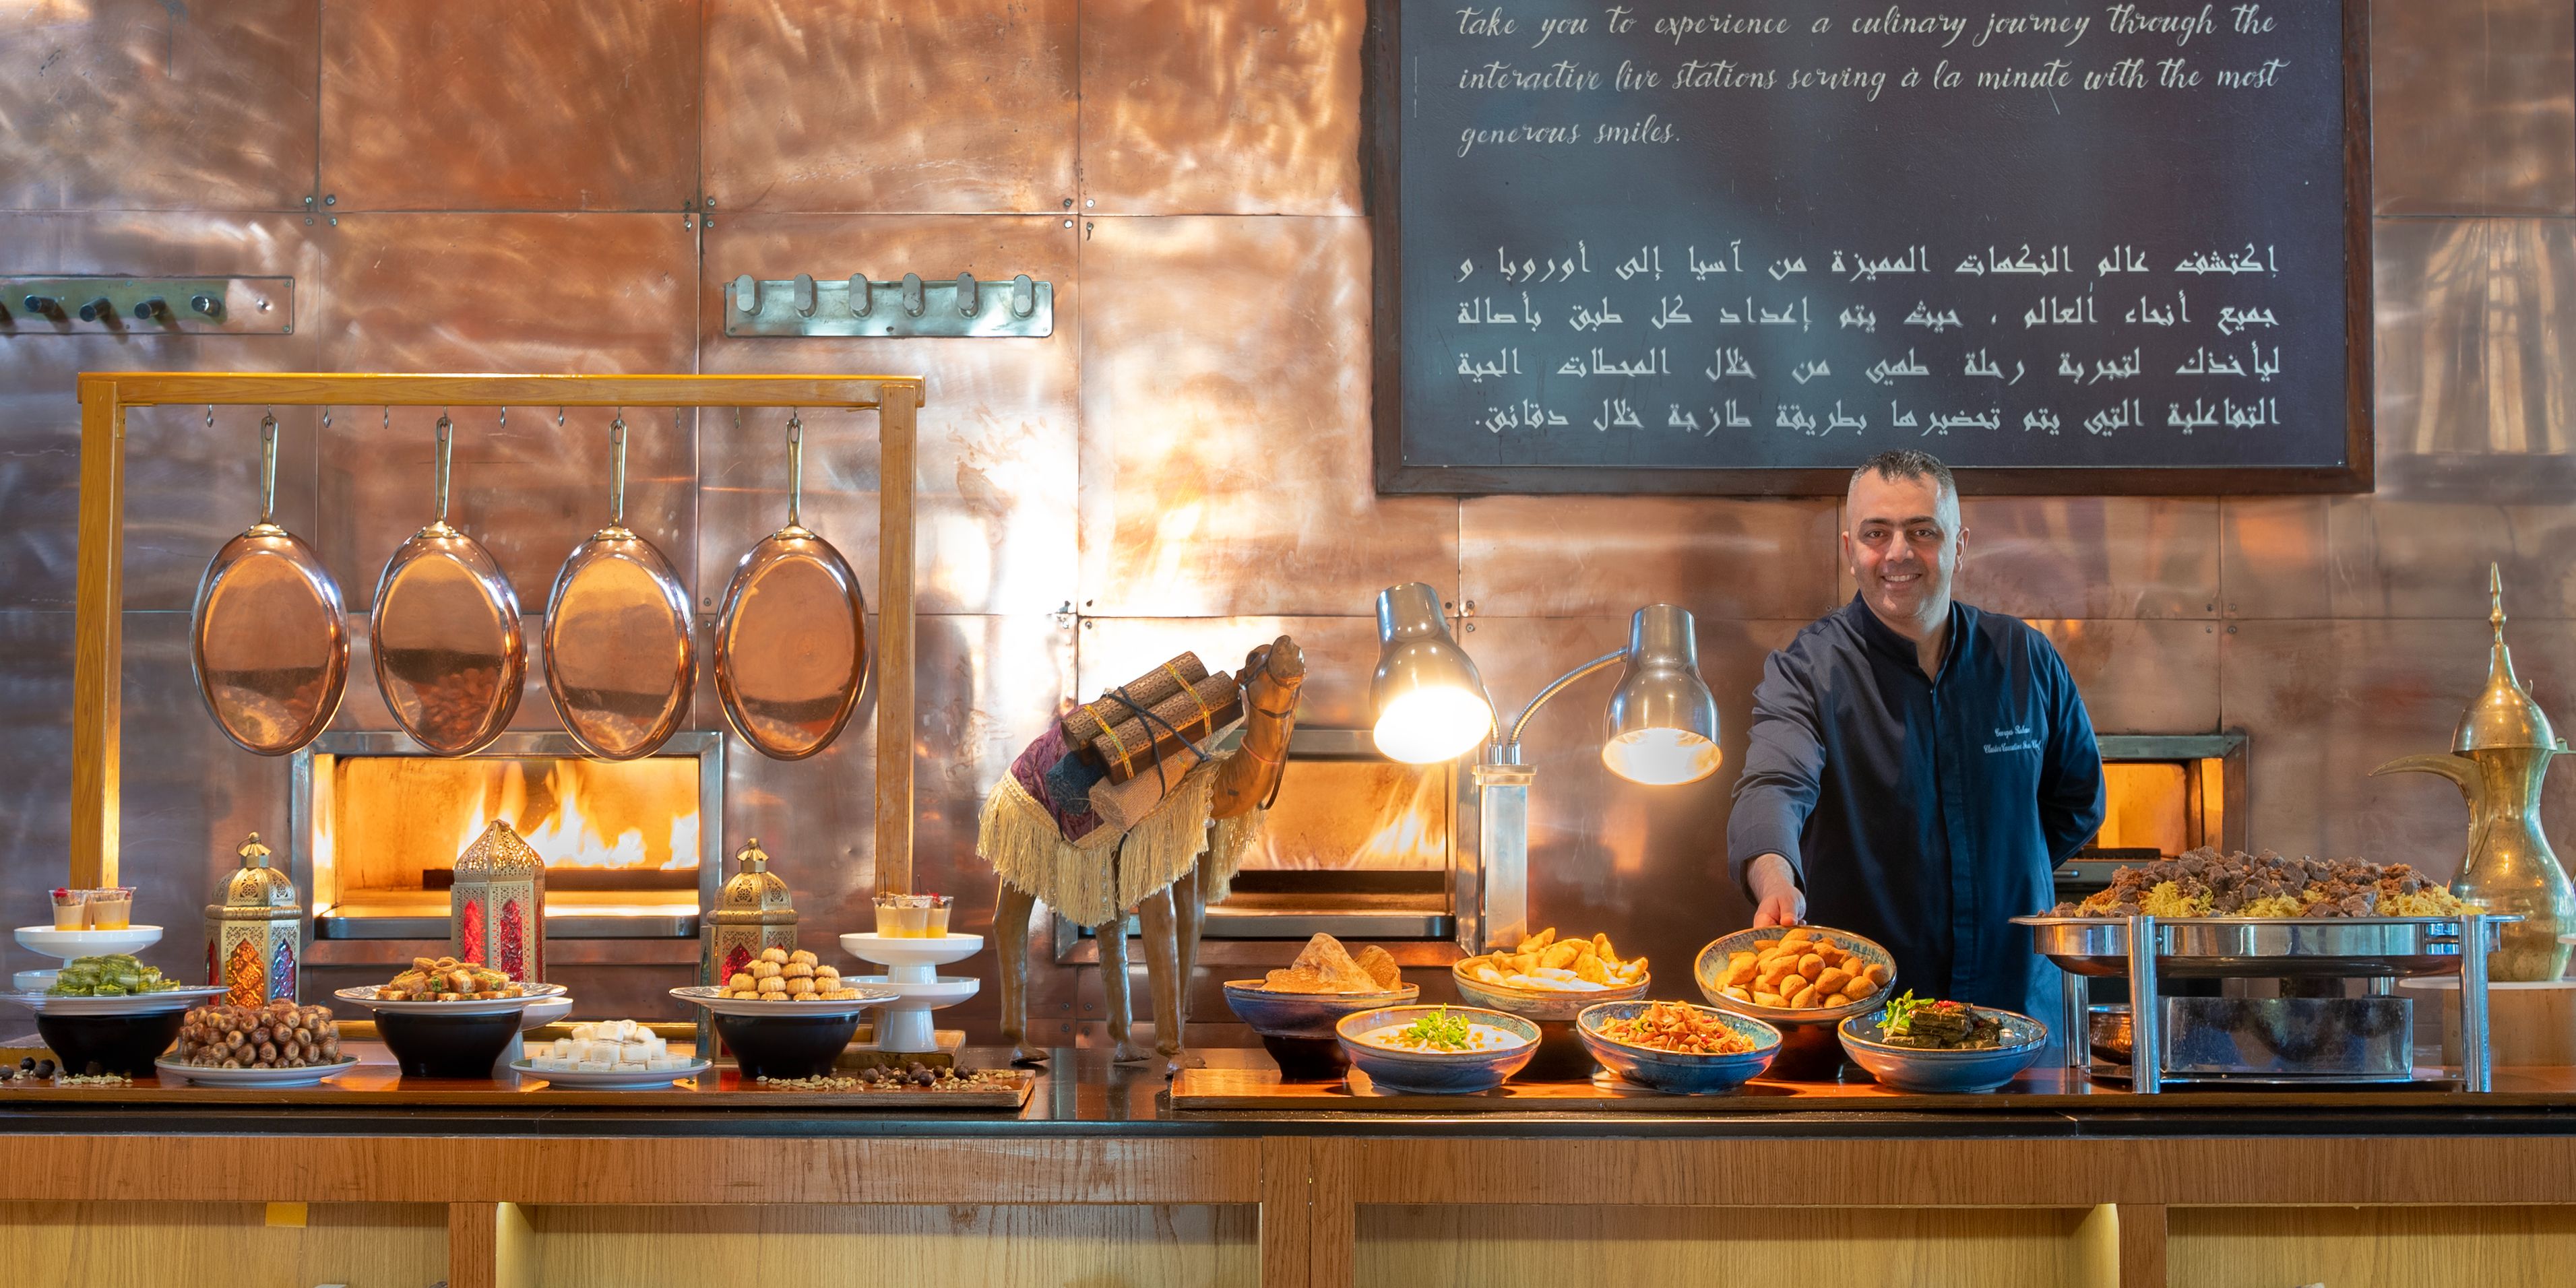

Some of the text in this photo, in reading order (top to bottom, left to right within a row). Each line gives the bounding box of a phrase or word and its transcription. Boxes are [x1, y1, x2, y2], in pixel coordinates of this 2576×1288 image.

[1455, 3, 2277, 49] take you to experience a culinary journey through the
[1459, 57, 2291, 102] interactive live stations serving à la minute with the most
[1457, 114, 1680, 158] generous smiles.
[1457, 258, 1474, 283] و
[1498, 239, 1591, 283] أوروبا
[1614, 245, 1664, 282] إلى
[1688, 238, 1744, 282] آسيا
[1768, 256, 1808, 281] من
[1831, 245, 1931, 282] المميزة
[1954, 243, 2074, 277] النكهات
[2098, 244, 2150, 278] عالم
[1457, 290, 1542, 333] بأصالة
[1569, 296, 1624, 333] طبق
[1651, 294, 1693, 329] كل
[1720, 296, 1813, 333] إعداد
[1839, 304, 1877, 333] يتم
[1904, 300, 1964, 333] حيث
[2125, 289, 2192, 327] أنحاء
[2217, 307, 2280, 336] جميع
[1457, 340, 2281, 386] ليأخذك لتجربة رحلة طهي من خلال المحطات الحية
[1475, 397, 2281, 437] التفاعلية التي يتم تحضيرها بطريقة طازجة خلال دقائق.
